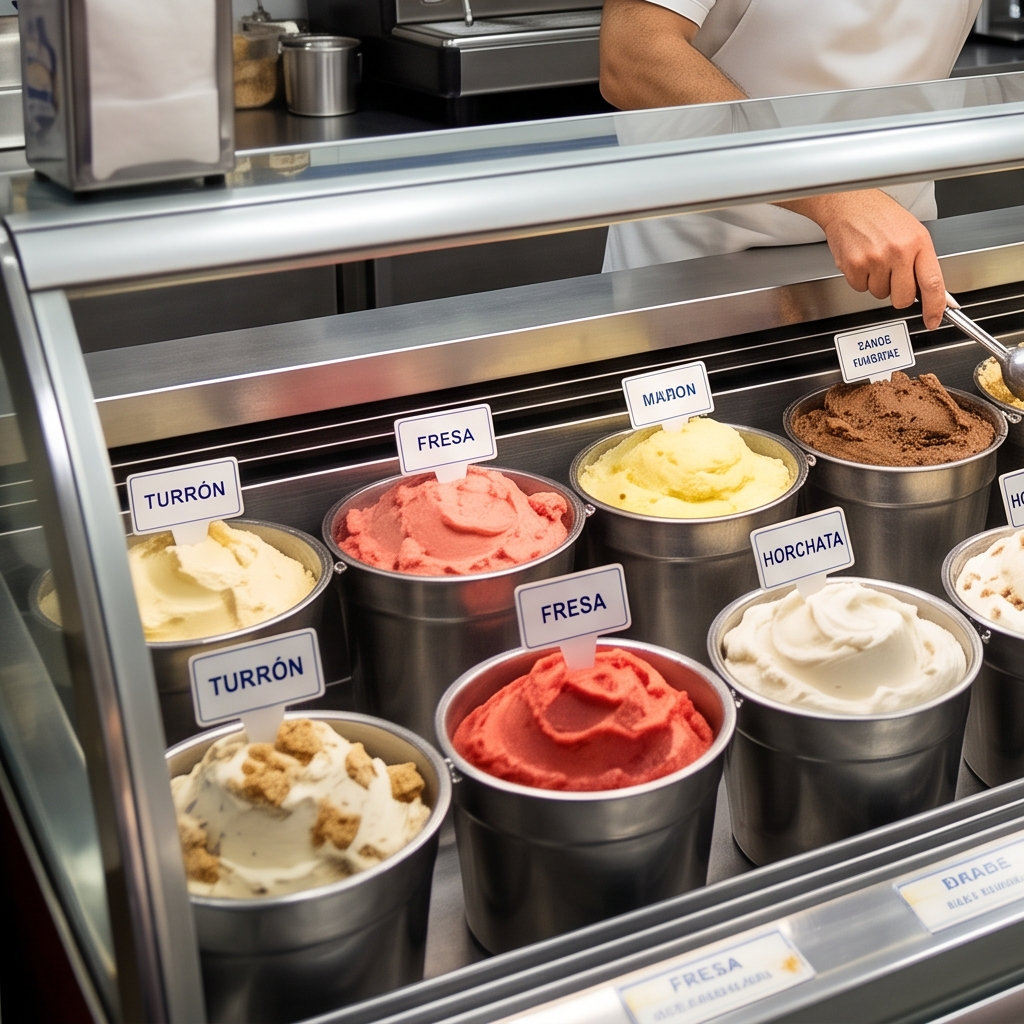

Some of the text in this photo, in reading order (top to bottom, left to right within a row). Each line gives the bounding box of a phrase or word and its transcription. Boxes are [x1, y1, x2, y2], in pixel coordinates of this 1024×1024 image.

[417, 428, 475, 451] FRESA
[144, 480, 226, 510] TURRÓN
[763, 531, 844, 567] HORCHATA
[541, 593, 607, 624] FRESA
[208, 656, 304, 696] TURRÓN
[669, 957, 743, 993] FRESA
